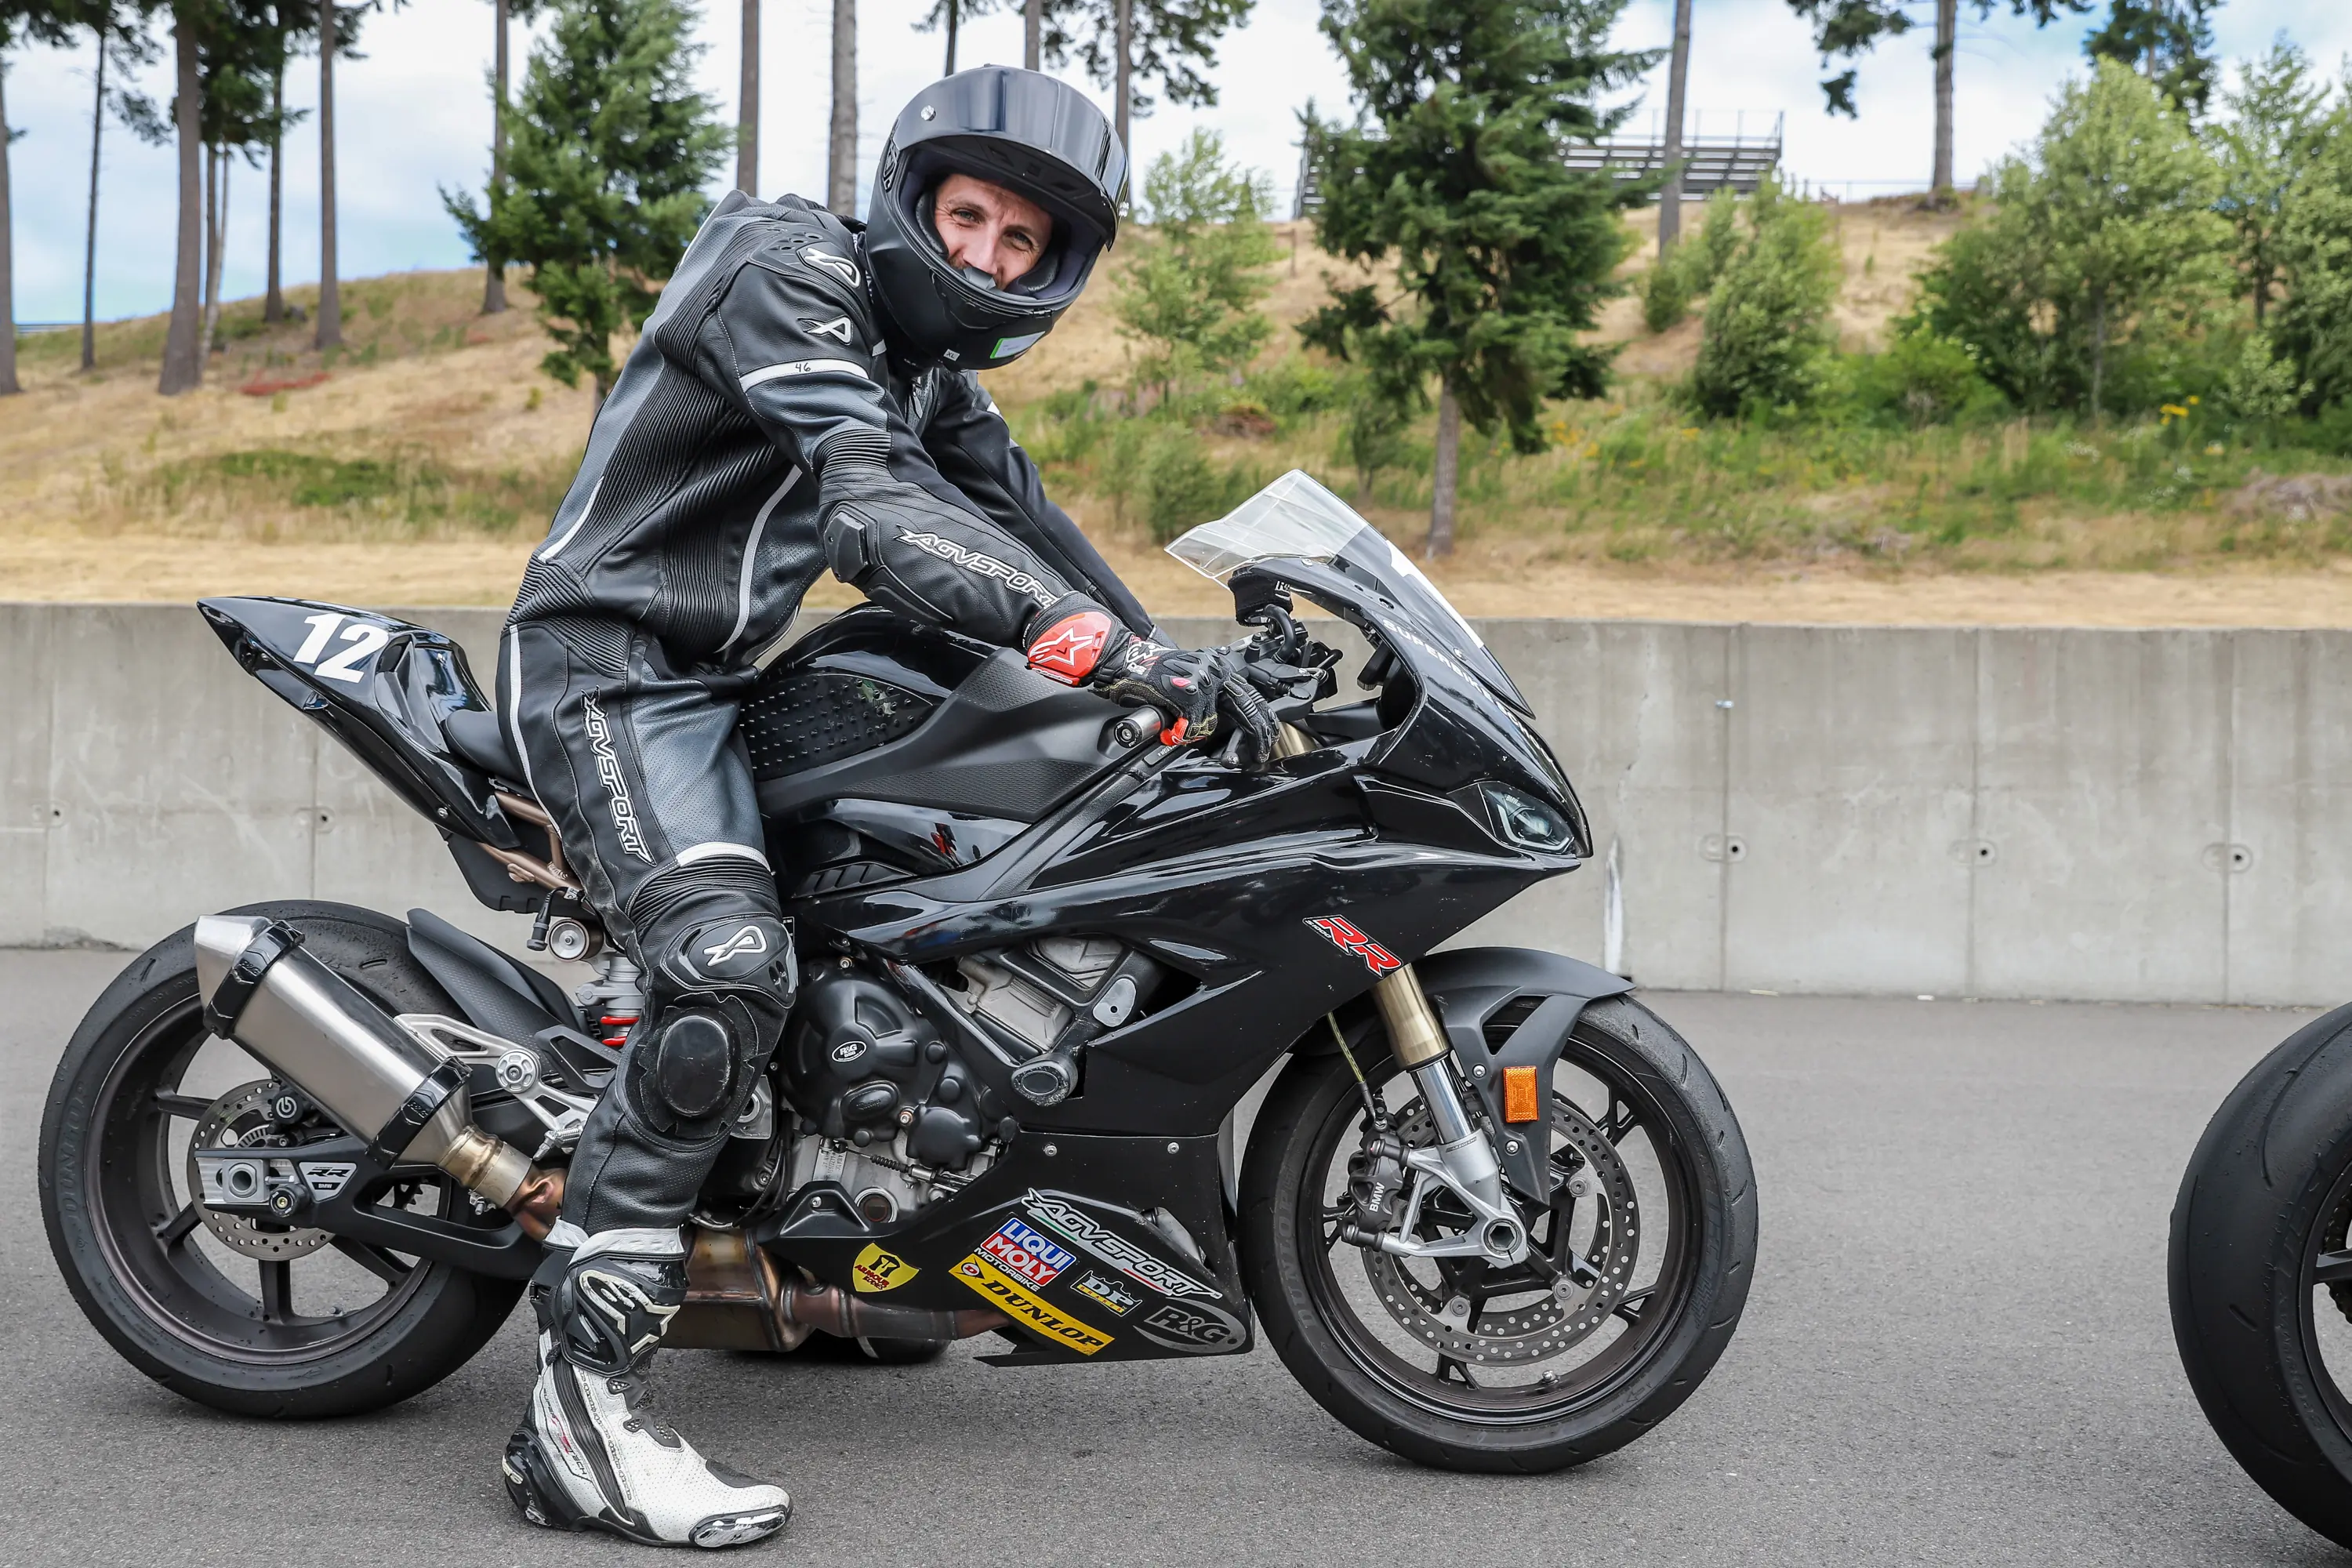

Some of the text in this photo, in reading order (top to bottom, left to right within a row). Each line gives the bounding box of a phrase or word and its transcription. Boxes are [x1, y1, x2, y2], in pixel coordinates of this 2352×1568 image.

[795, 362, 811, 372] 46
[946, 350, 956, 359] XL
[293, 613, 389, 683] 12
[581, 688, 656, 866] AGVSPORT
[1305, 920, 1332, 938] S1000
[1312, 916, 1402, 978] RR
[839, 1044, 858, 1056] R&G
[307, 1168, 351, 1178] RR
[1369, 1181, 1385, 1213] BMW
[985, 1235, 1057, 1282] MOLY
[1002, 1221, 1072, 1269] LIQUI
[1022, 1189, 1221, 1298] AGVSPORT
[855, 1264, 890, 1286] ARMOUR
[974, 1247, 1041, 1292] MOTORBIKE
[1080, 1286, 1122, 1312] BRAKES
[1082, 1276, 1134, 1305] DP
[981, 1279, 1105, 1347] DUNLOP
[1145, 1305, 1232, 1346] R&G
